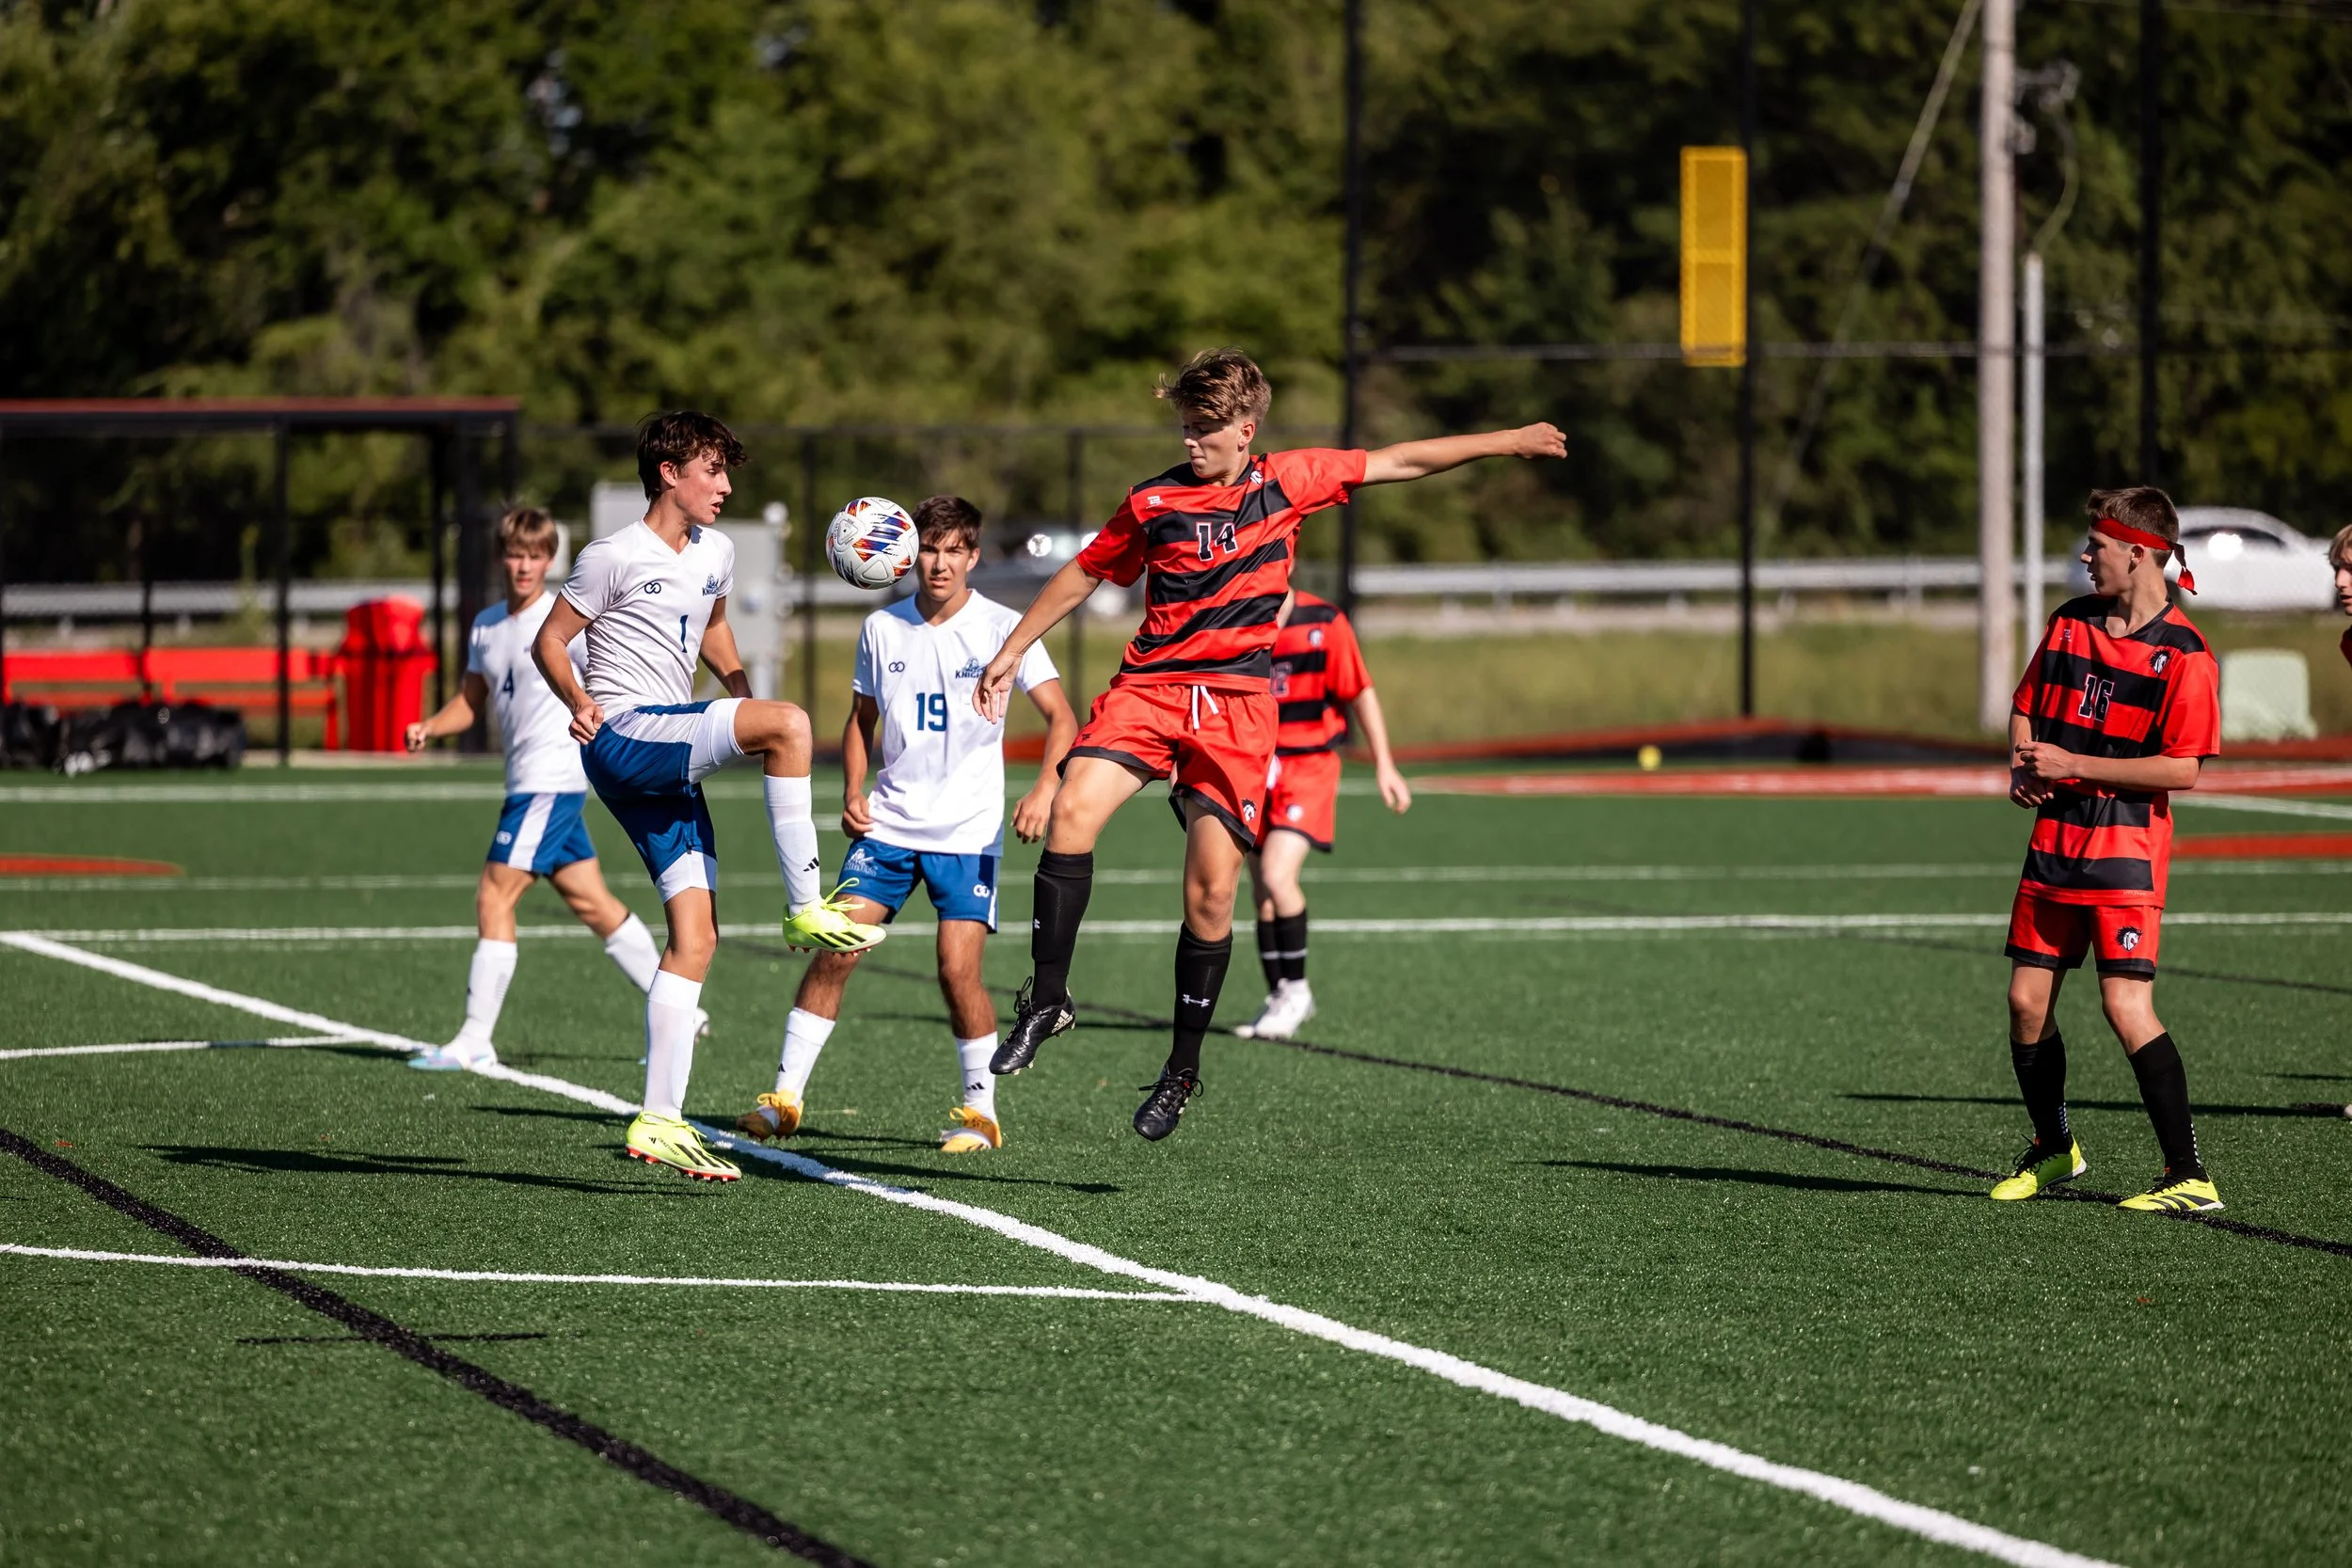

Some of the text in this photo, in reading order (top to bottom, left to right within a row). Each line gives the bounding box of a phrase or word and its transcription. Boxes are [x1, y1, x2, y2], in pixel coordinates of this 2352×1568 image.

[1197, 522, 1238, 562] 14
[679, 614, 689, 653] 1
[502, 667, 515, 701] 4
[2078, 673, 2115, 722] 16
[916, 692, 947, 732] 19
